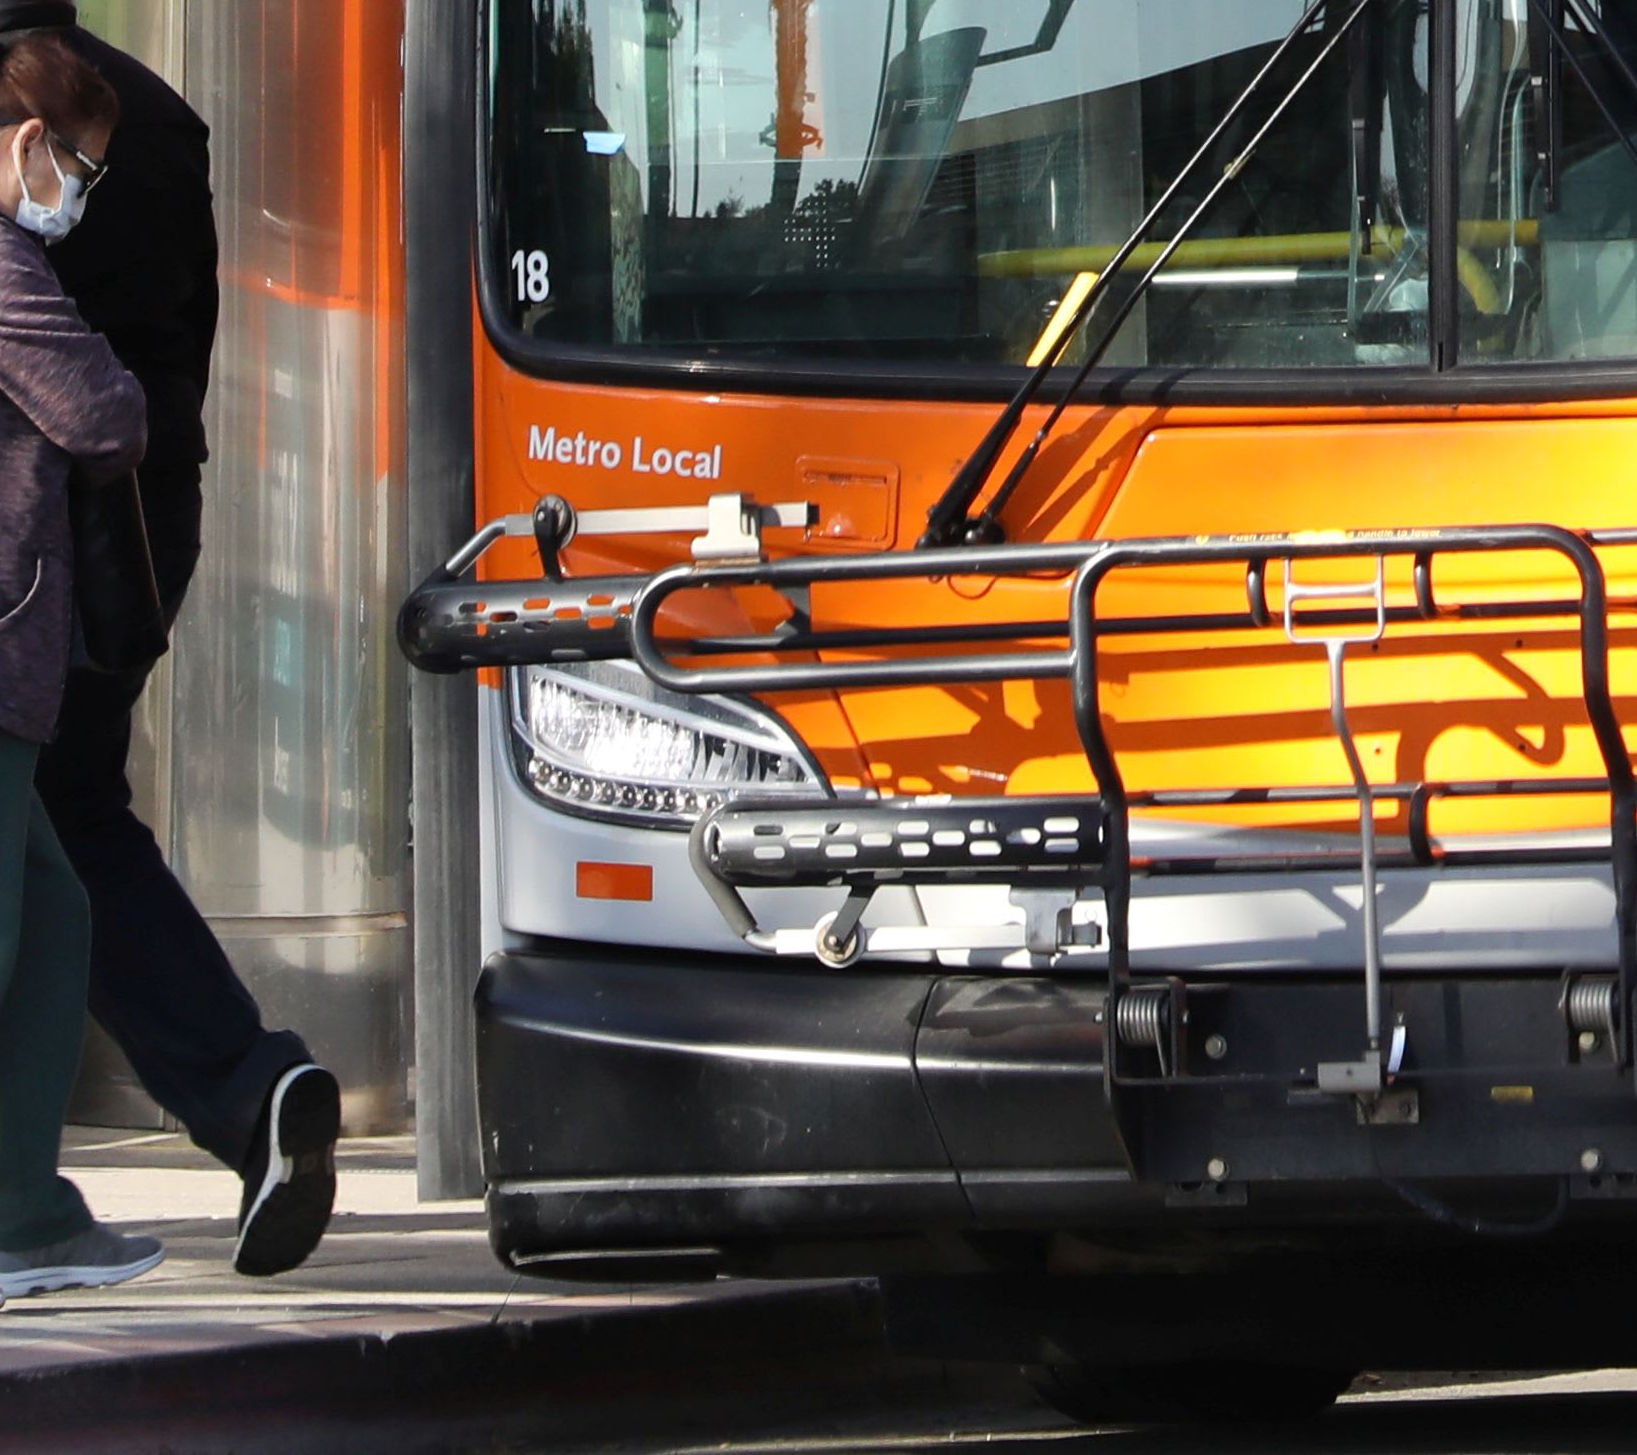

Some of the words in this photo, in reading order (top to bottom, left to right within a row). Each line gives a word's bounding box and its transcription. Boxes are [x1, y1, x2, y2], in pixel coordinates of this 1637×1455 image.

[511, 249, 551, 303] 18
[527, 423, 623, 470] Metro
[631, 435, 723, 480] Local
